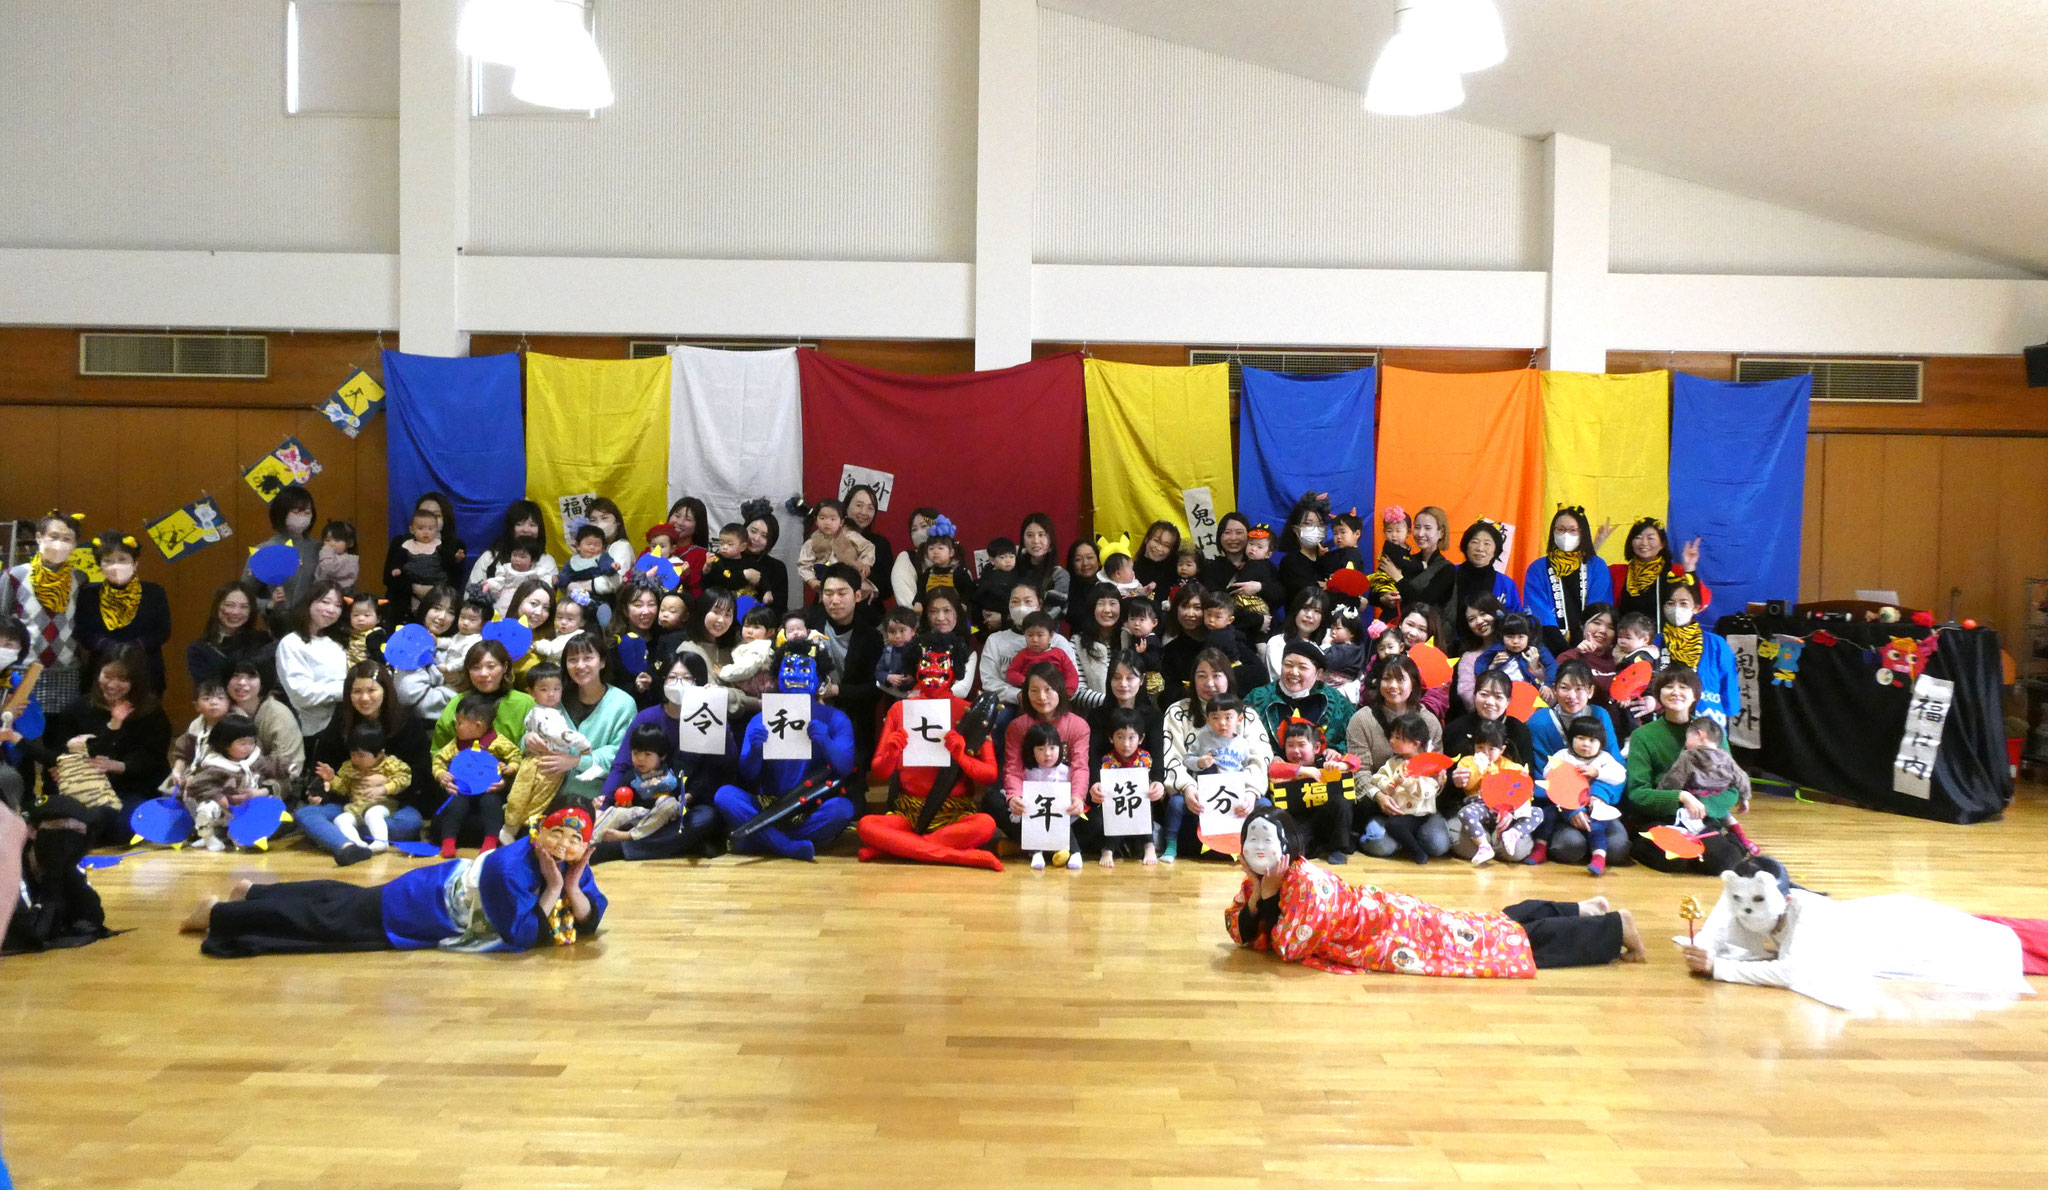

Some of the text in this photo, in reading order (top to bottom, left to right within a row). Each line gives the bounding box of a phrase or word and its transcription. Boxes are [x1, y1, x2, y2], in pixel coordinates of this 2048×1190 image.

[1191, 503, 1216, 550] 鬼は
[683, 702, 724, 736] 令
[767, 708, 806, 740] 和
[911, 715, 943, 743] 七
[1902, 694, 1944, 780] 福は内
[1112, 781, 1142, 818] 節
[1206, 785, 1239, 814] 分
[1301, 782, 1329, 808] 福
[1029, 794, 1063, 832] 年
